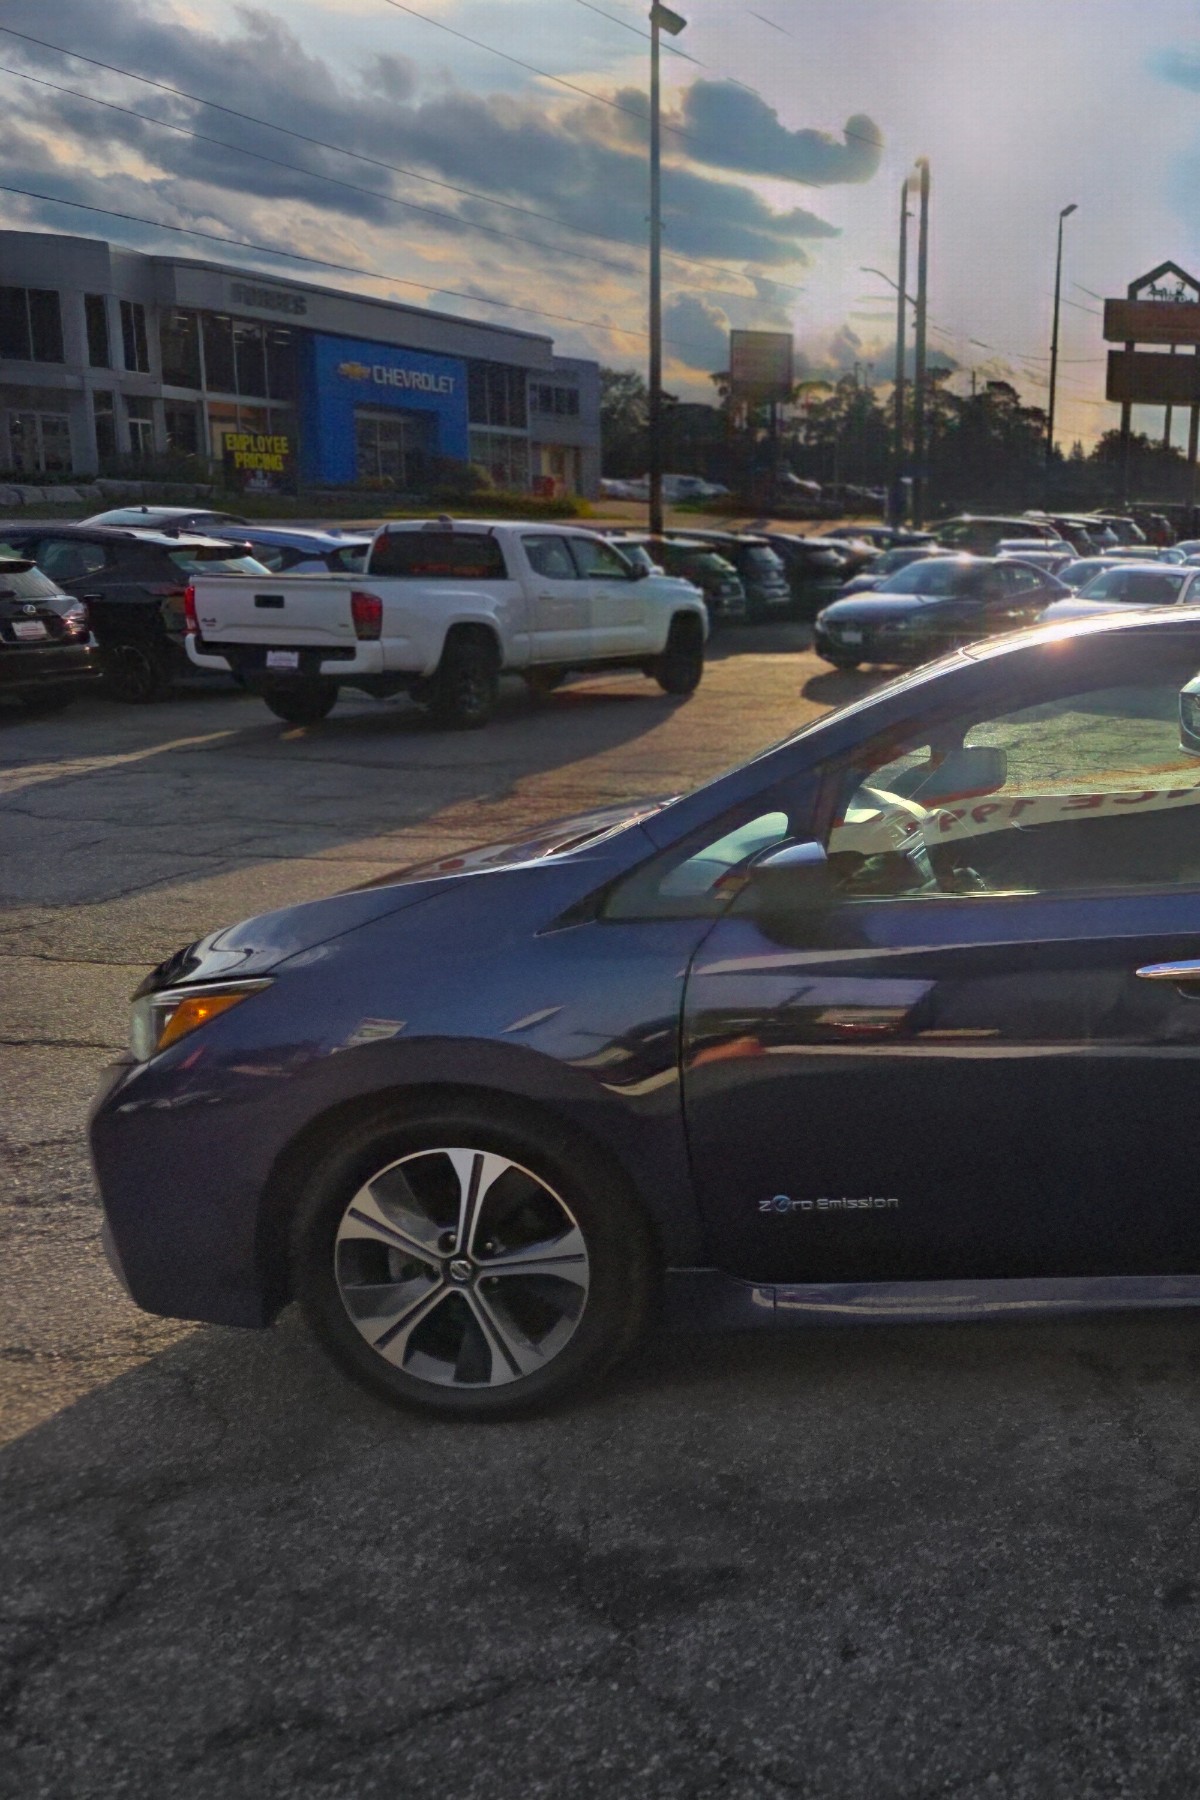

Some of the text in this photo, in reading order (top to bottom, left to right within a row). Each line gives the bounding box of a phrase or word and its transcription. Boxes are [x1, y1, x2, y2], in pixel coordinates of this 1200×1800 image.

[372, 365, 455, 394] CHEVROLET
[225, 433, 288, 453] EMPLOYEE
[235, 452, 284, 470] PRICING
[816, 1196, 899, 1210] Emission
